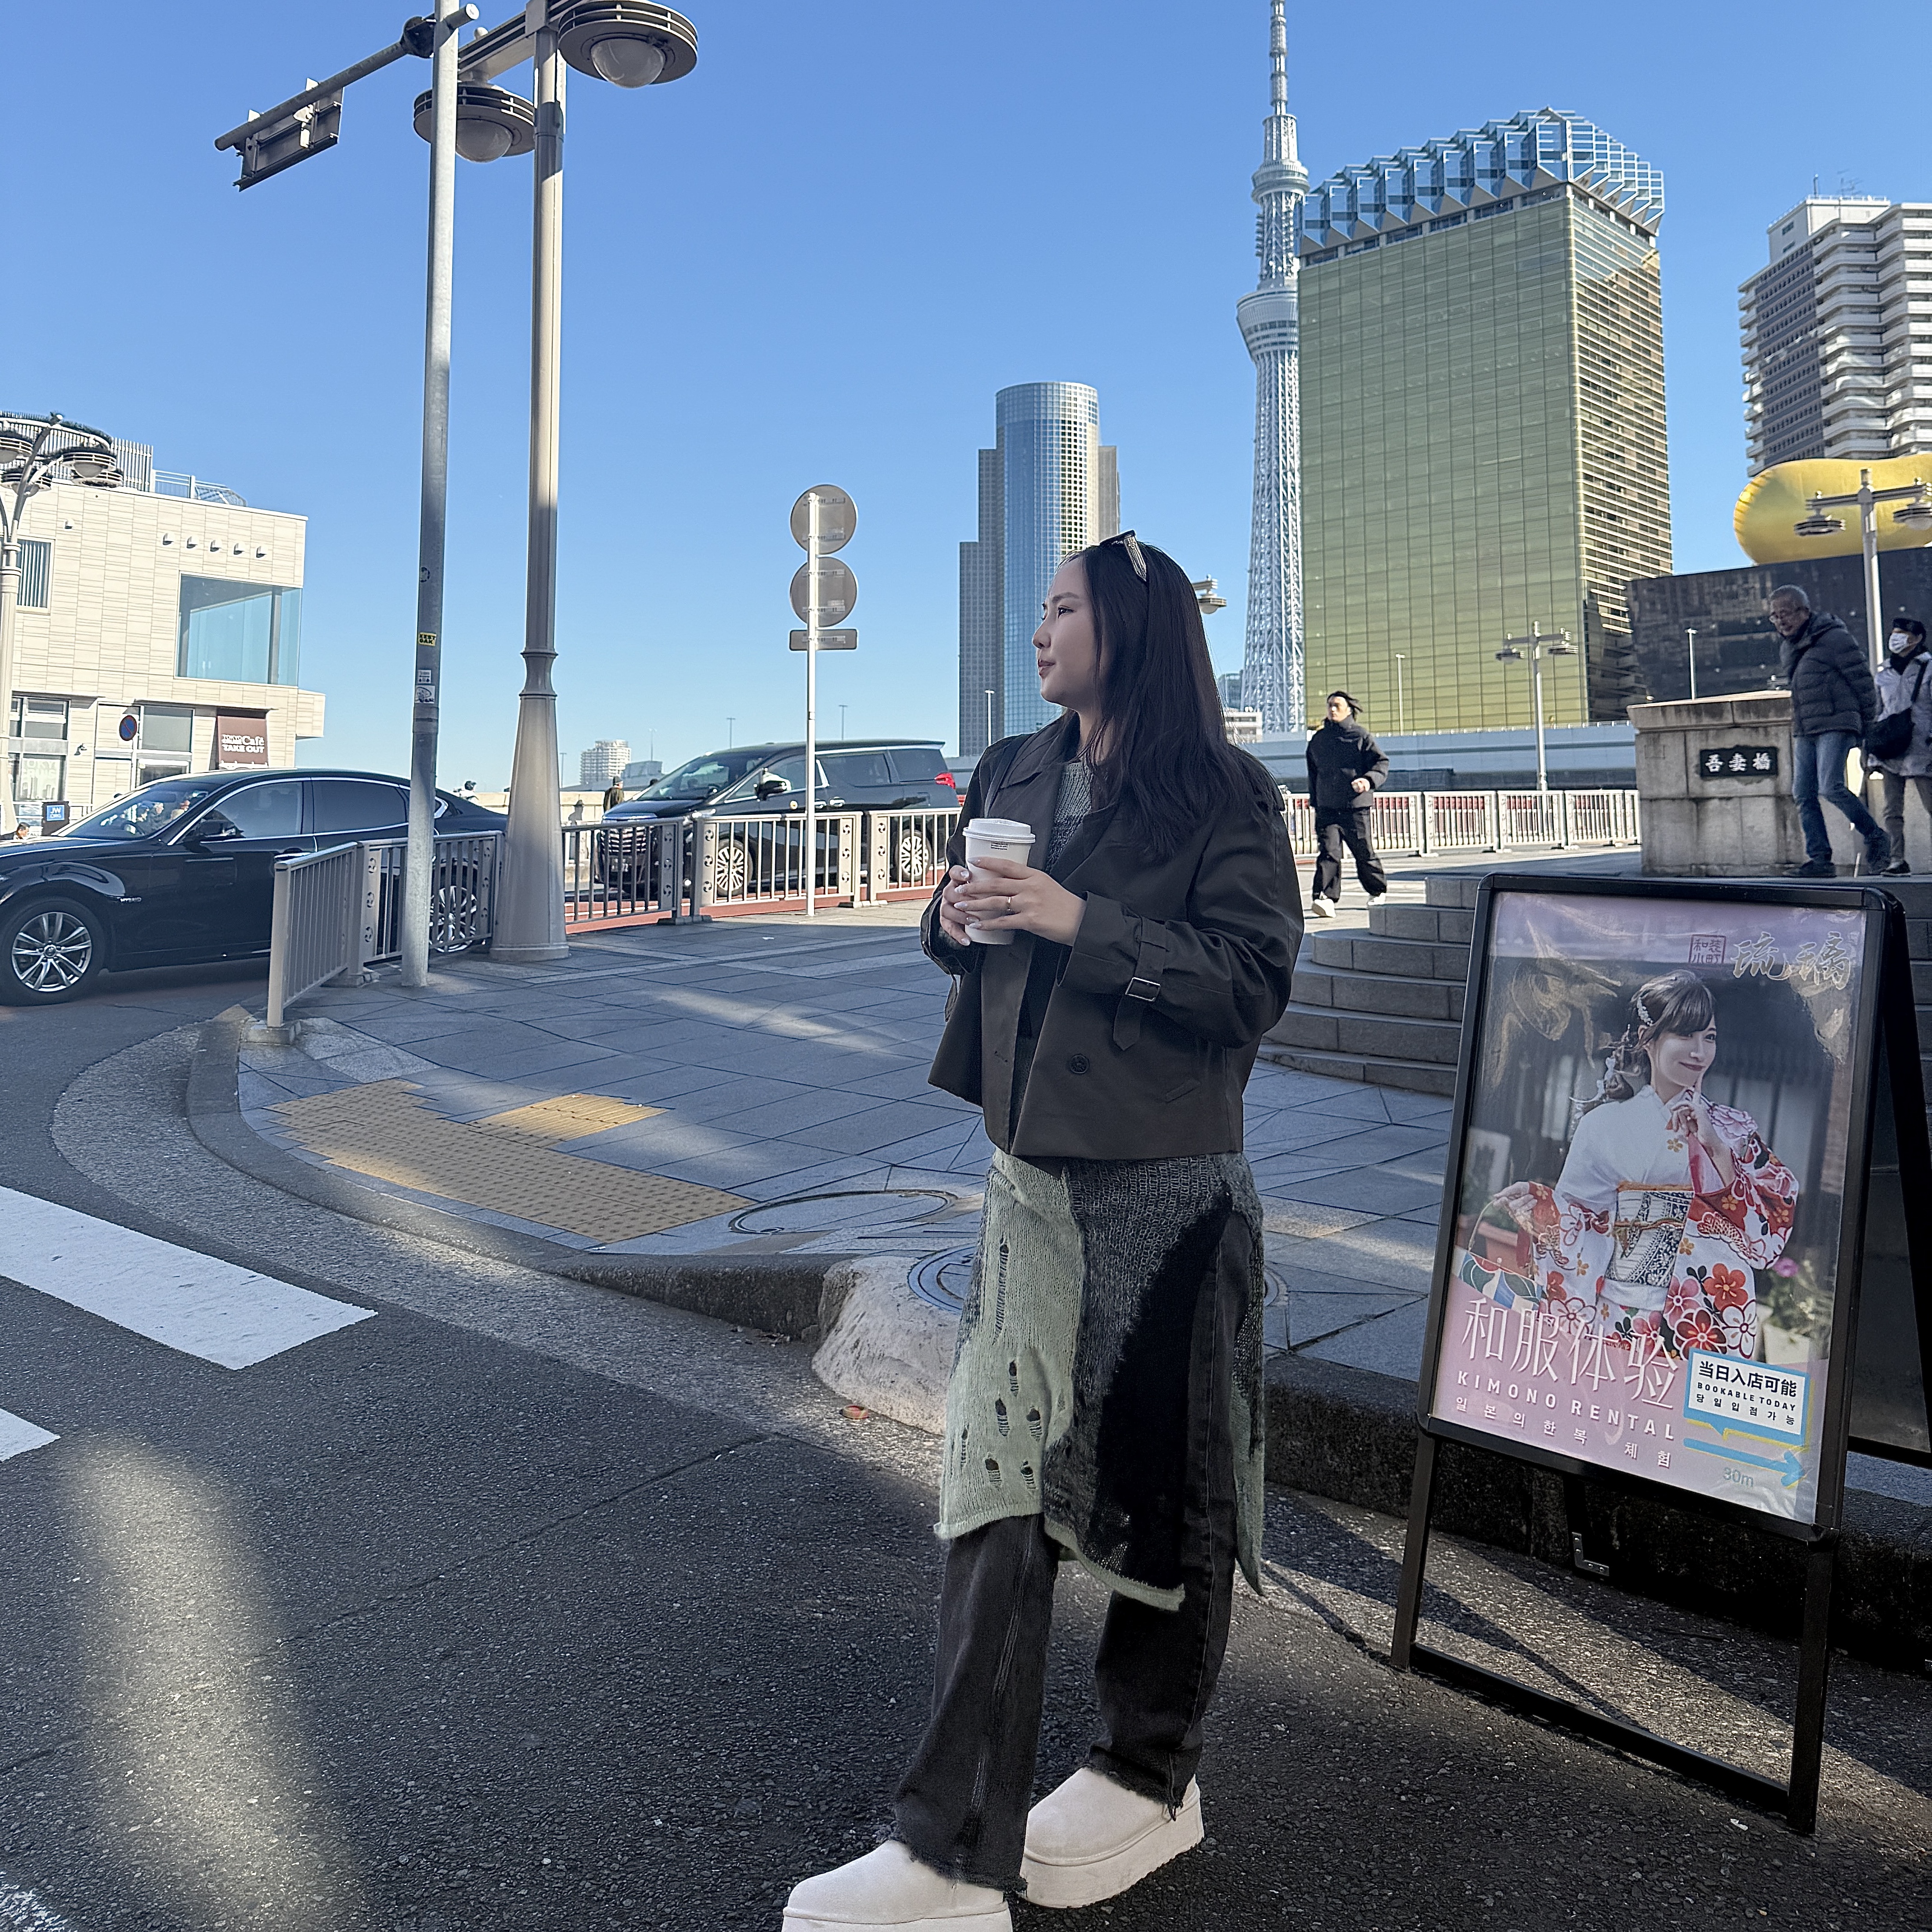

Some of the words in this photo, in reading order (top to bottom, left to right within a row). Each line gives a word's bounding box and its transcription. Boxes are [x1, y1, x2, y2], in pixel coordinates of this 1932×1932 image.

[222, 744, 245, 752] TAKE
[246, 745, 264, 753] OUT
[1705, 753, 1771, 773] 吾妻橋
[1462, 1297, 1678, 1409] 和服体验
[1698, 1361, 1796, 1397] 当日入店可能
[1457, 1370, 1557, 1408] KIMONO
[1571, 1399, 1674, 1440] RENTAL
[1697, 1382, 1755, 1402] BOOKABLE
[1759, 1397, 1796, 1411] TODAY
[1723, 1467, 1754, 1487] 30m
